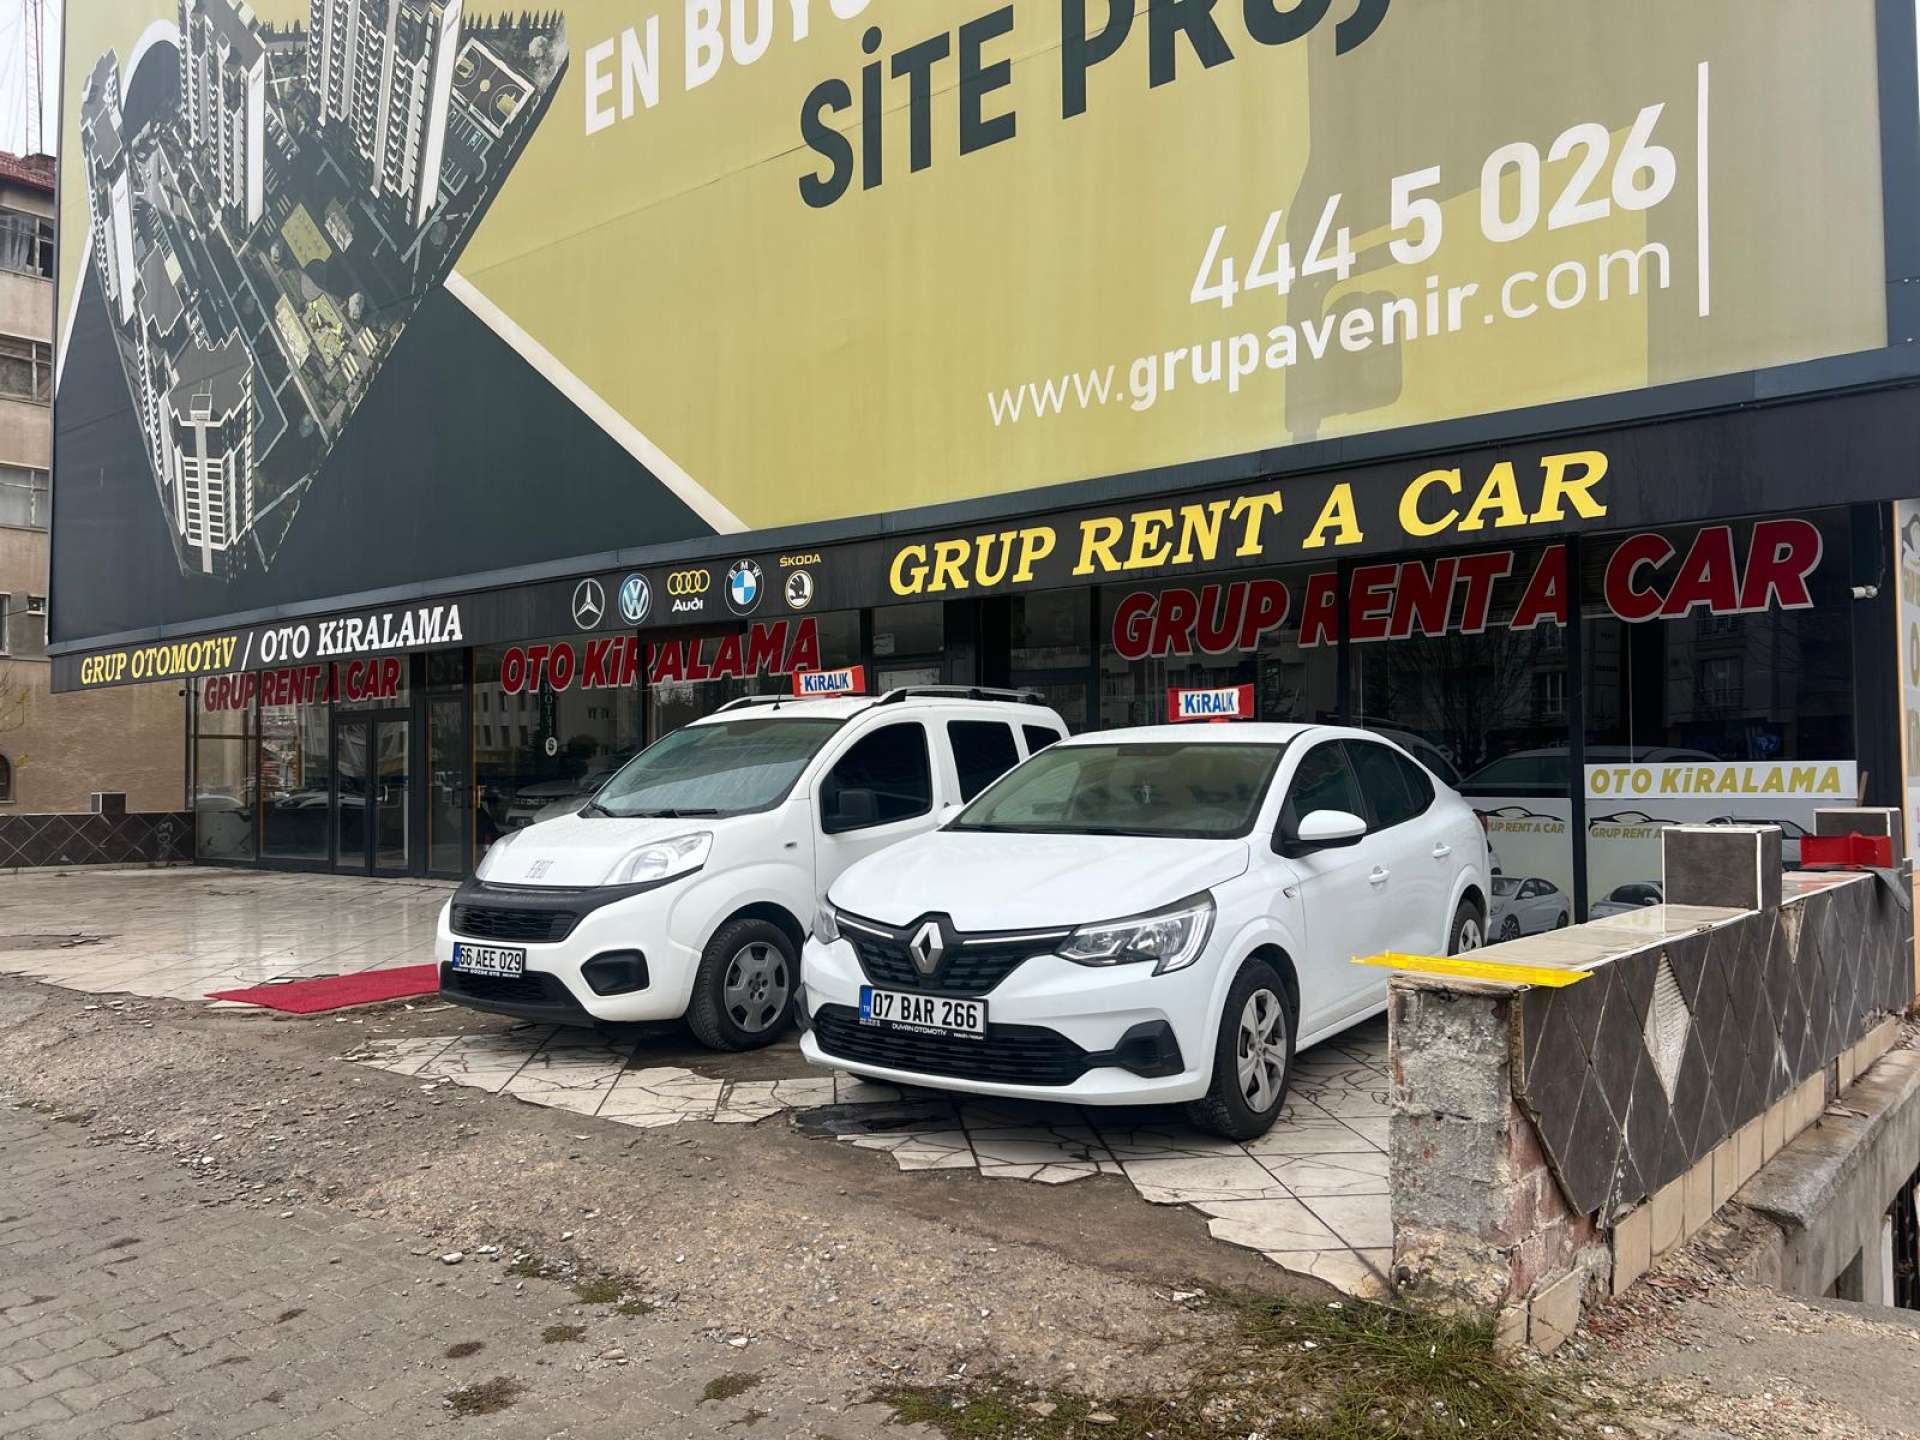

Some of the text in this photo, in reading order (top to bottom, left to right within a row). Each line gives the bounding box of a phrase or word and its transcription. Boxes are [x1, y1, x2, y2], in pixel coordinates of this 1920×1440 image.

[585, 15, 659, 136] EN
[1190, 102, 1677, 308] 444 5 026
[987, 241, 1672, 427] www.grupavenir.com
[890, 450, 1609, 596] GRUP RENT A CAR
[671, 599, 703, 613] Audi
[1112, 519, 1823, 661] GRUP RENT A CAR
[81, 648, 127, 685] GRUP
[260, 624, 310, 663] OTO
[502, 642, 575, 696] OTO
[204, 672, 256, 713] GRUP
[260, 665, 321, 707] RENT
[346, 656, 401, 702] CAR
[1590, 767, 1652, 794] OTO
[1543, 823, 1565, 834] CAR
[1591, 826, 1621, 839] GRUP
[460, 948, 522, 971] 66 AEE 029
[873, 993, 978, 1029] 07 BAR 266
